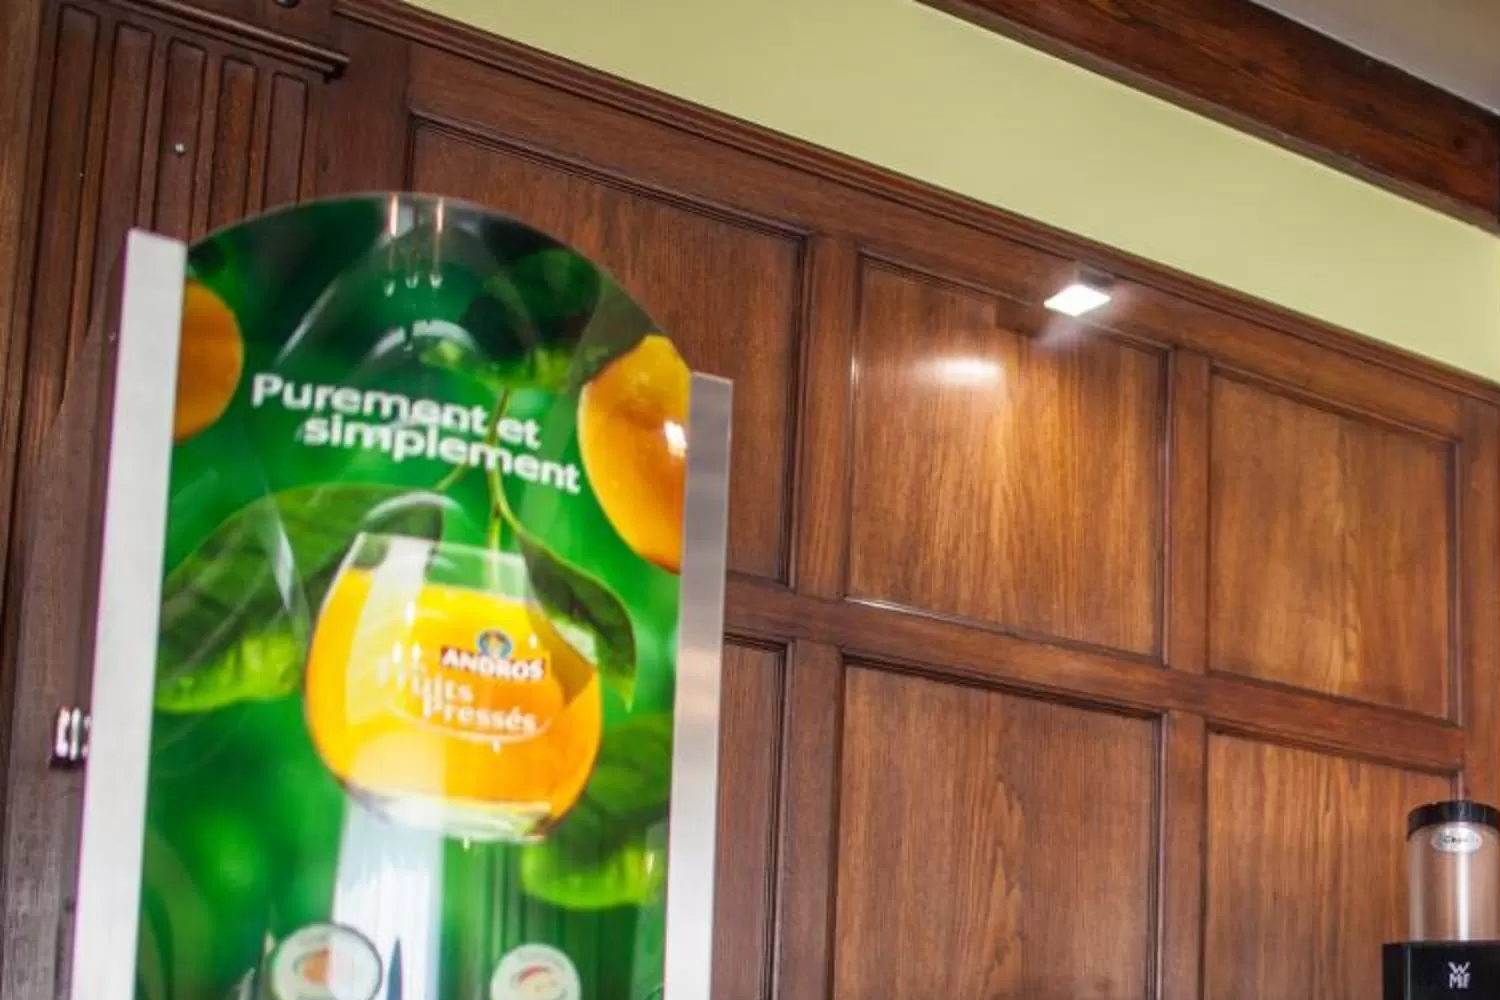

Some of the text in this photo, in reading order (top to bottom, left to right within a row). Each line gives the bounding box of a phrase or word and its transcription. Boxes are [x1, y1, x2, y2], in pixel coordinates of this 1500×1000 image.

[252, 373, 541, 449] Purement et
[302, 413, 581, 494] simplement
[441, 647, 545, 680] ANDROS
